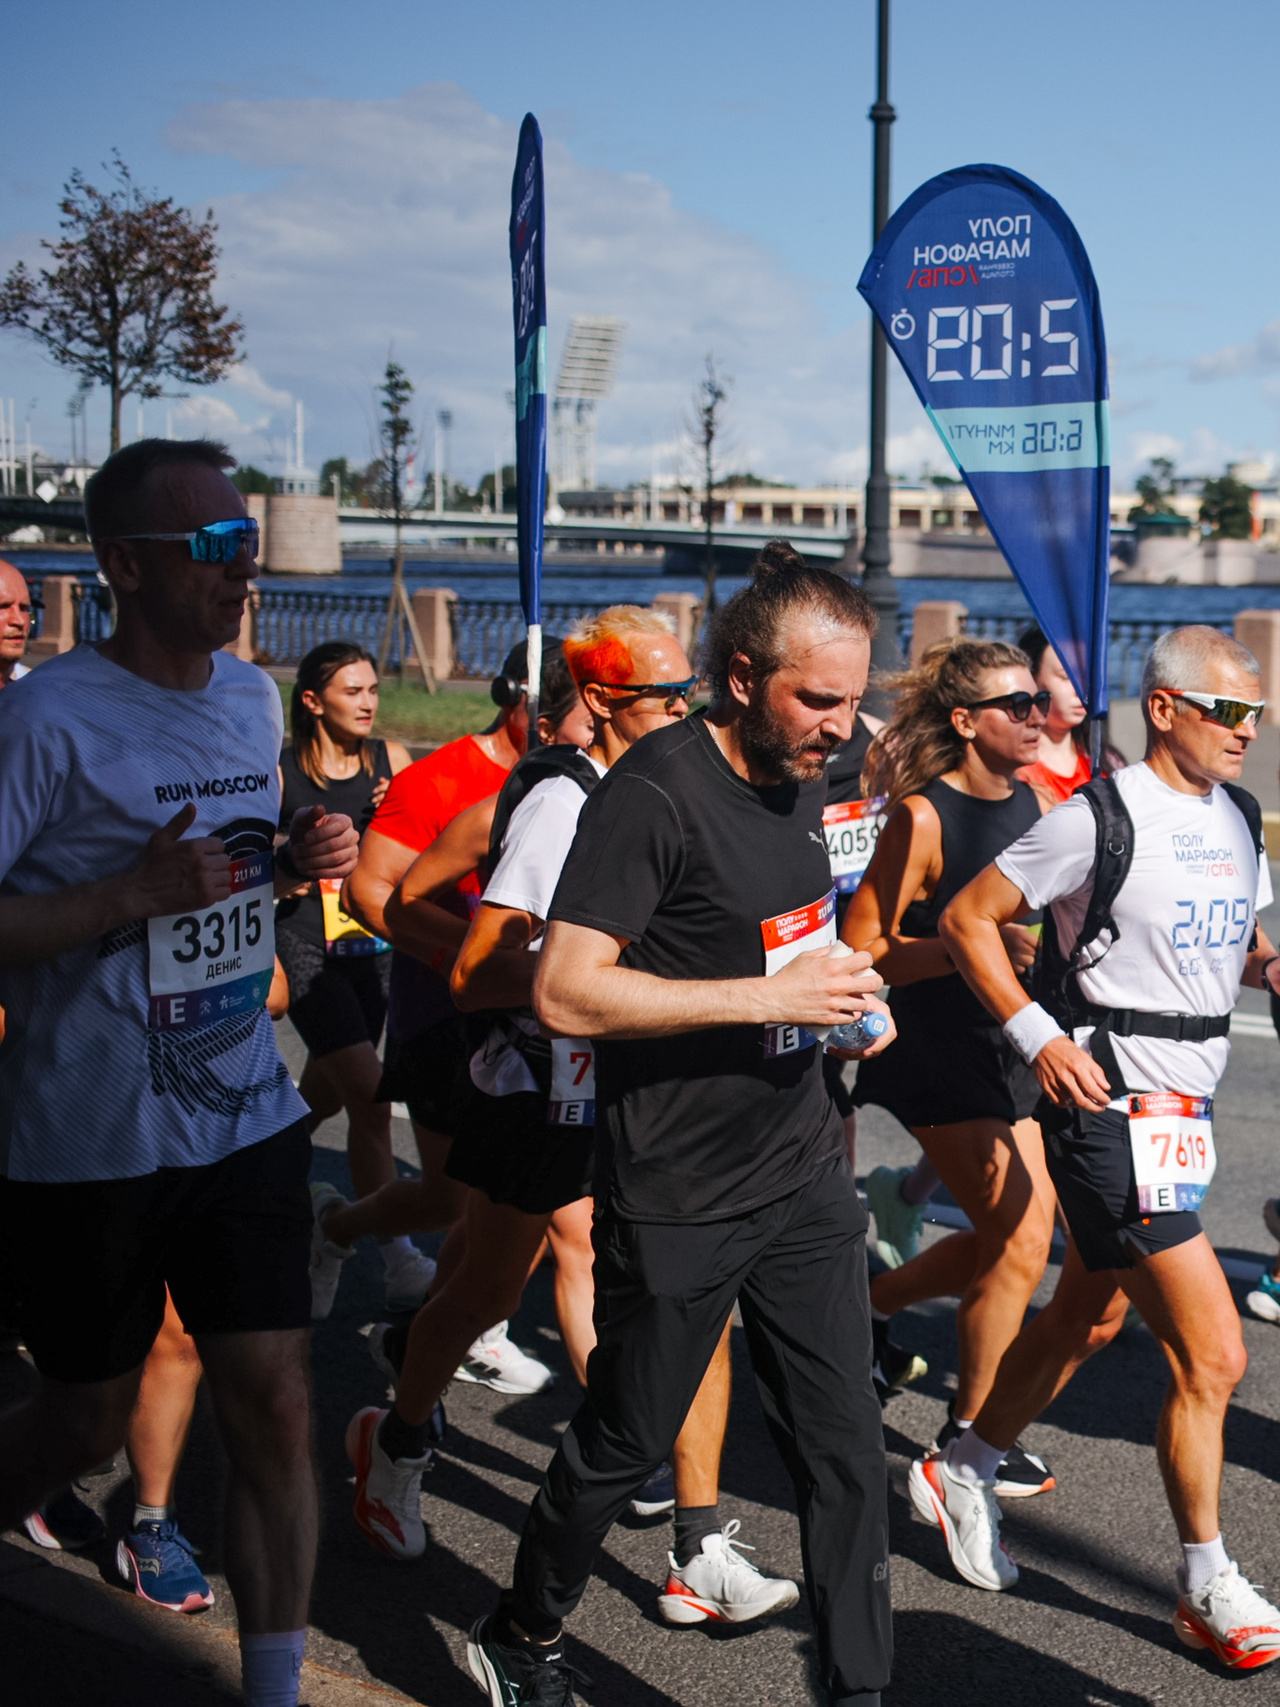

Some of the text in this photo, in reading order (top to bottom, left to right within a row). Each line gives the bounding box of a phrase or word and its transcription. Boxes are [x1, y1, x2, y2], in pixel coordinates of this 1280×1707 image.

[154, 773, 269, 804] RUN MOSCOW
[1171, 834, 1204, 847] ПОЛУ
[1174, 848, 1233, 862] МАРАФОН
[172, 899, 261, 964] 3315
[775, 914, 795, 928] ПОЛУ
[777, 918, 808, 937] МАРАФОН
[1172, 898, 1249, 950] 2:09
[205, 956, 242, 981] ДЕНИС
[169, 997, 186, 1024] E
[783, 1026, 796, 1049] E
[565, 1104, 580, 1122] E
[1150, 1133, 1206, 1169] 7619
[1158, 1188, 1170, 1207] E
